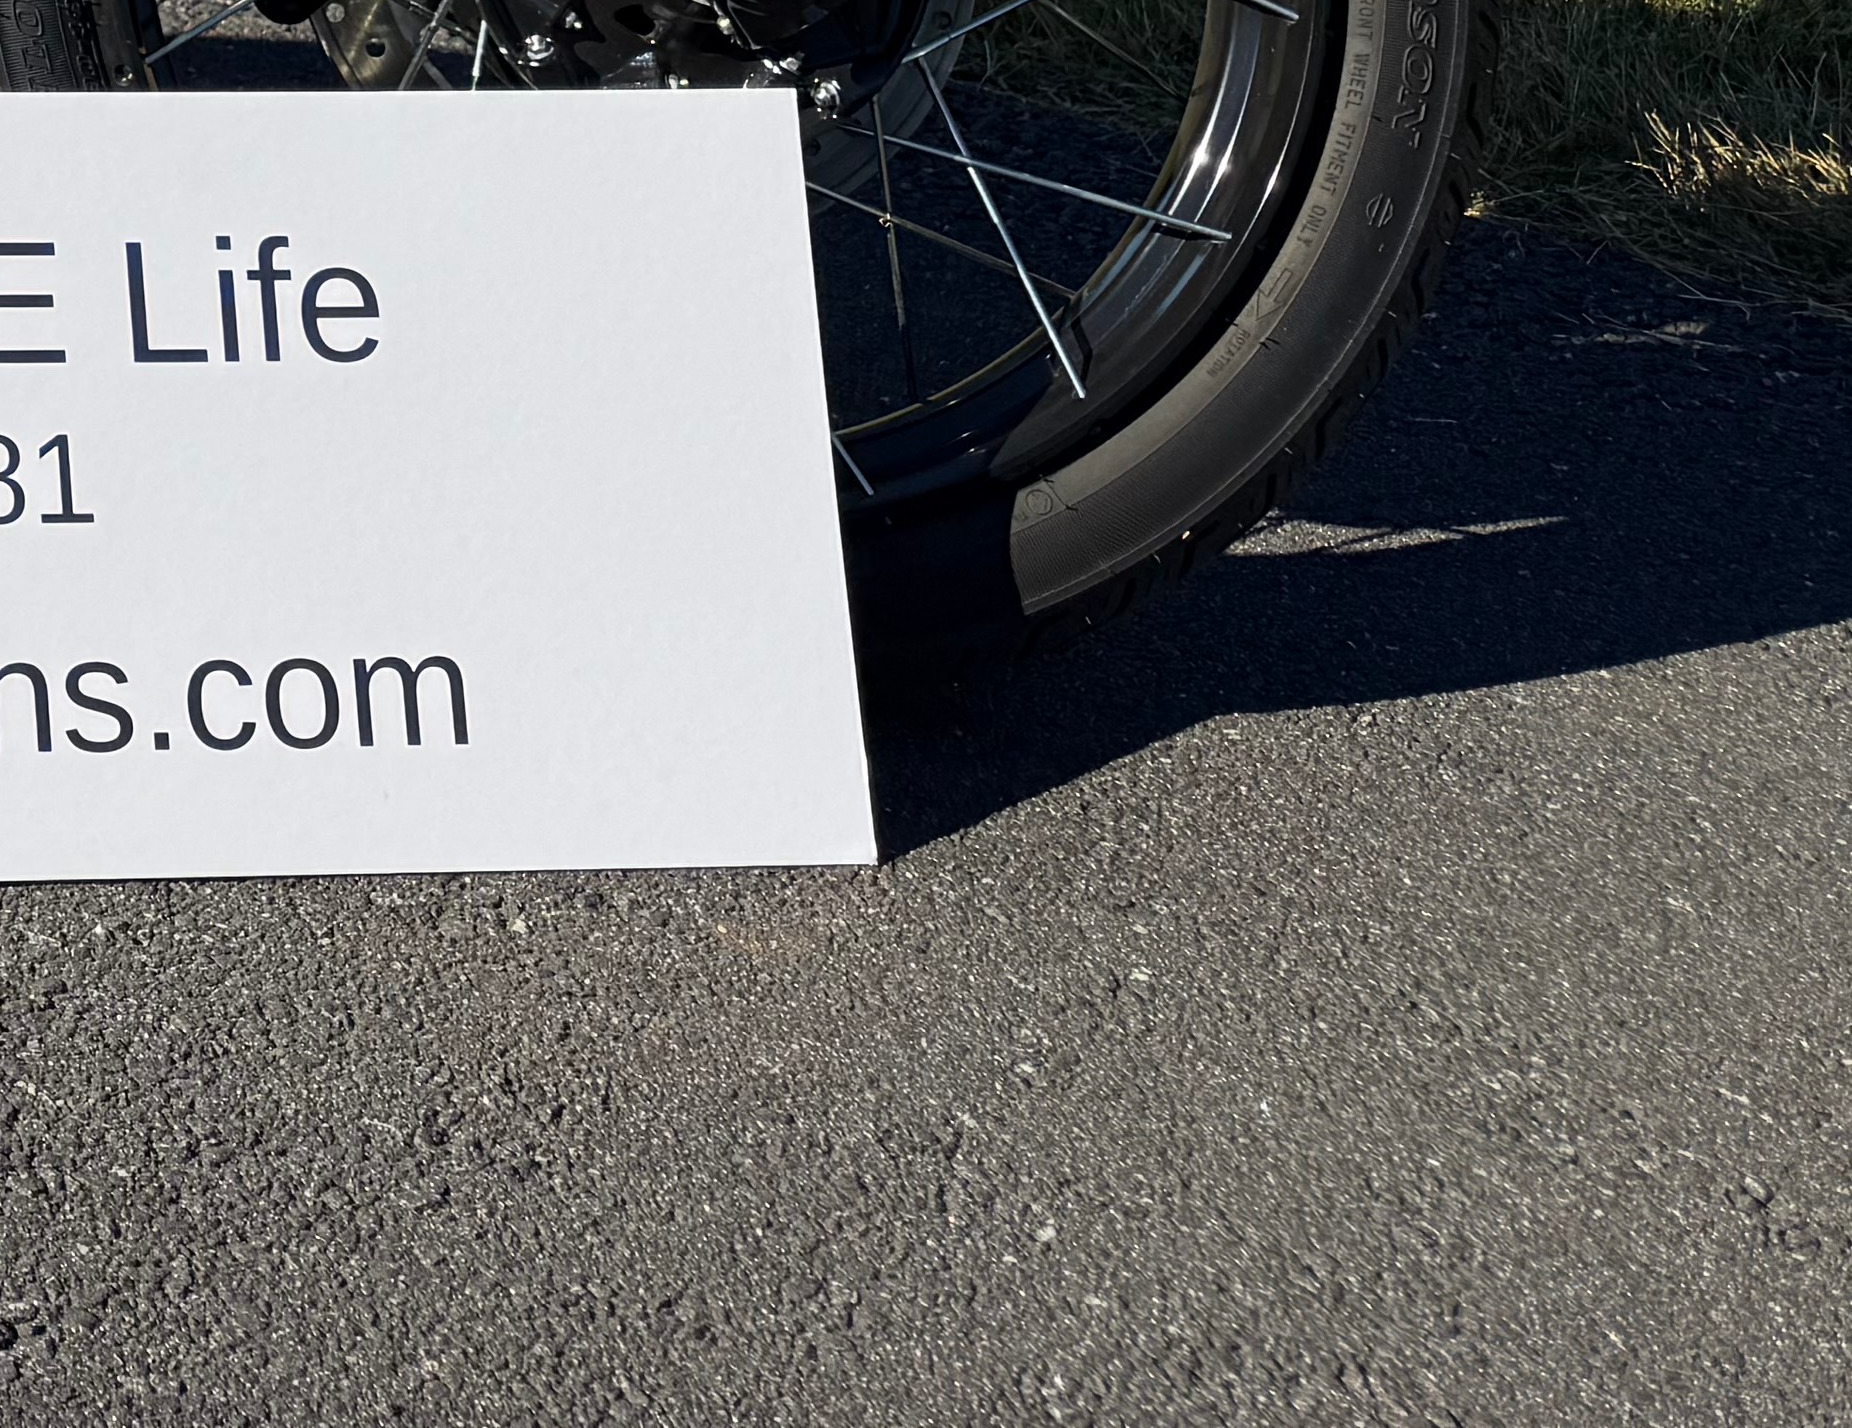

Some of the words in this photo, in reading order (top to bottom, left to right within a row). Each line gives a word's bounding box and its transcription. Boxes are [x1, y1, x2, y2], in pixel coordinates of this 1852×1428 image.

[1345, 54, 1369, 109] WHEEL
[1318, 122, 1355, 196] FITMENT
[1296, 204, 1325, 246] ONLY
[125, 235, 381, 363] Life
[1205, 328, 1250, 378] ROTATION
